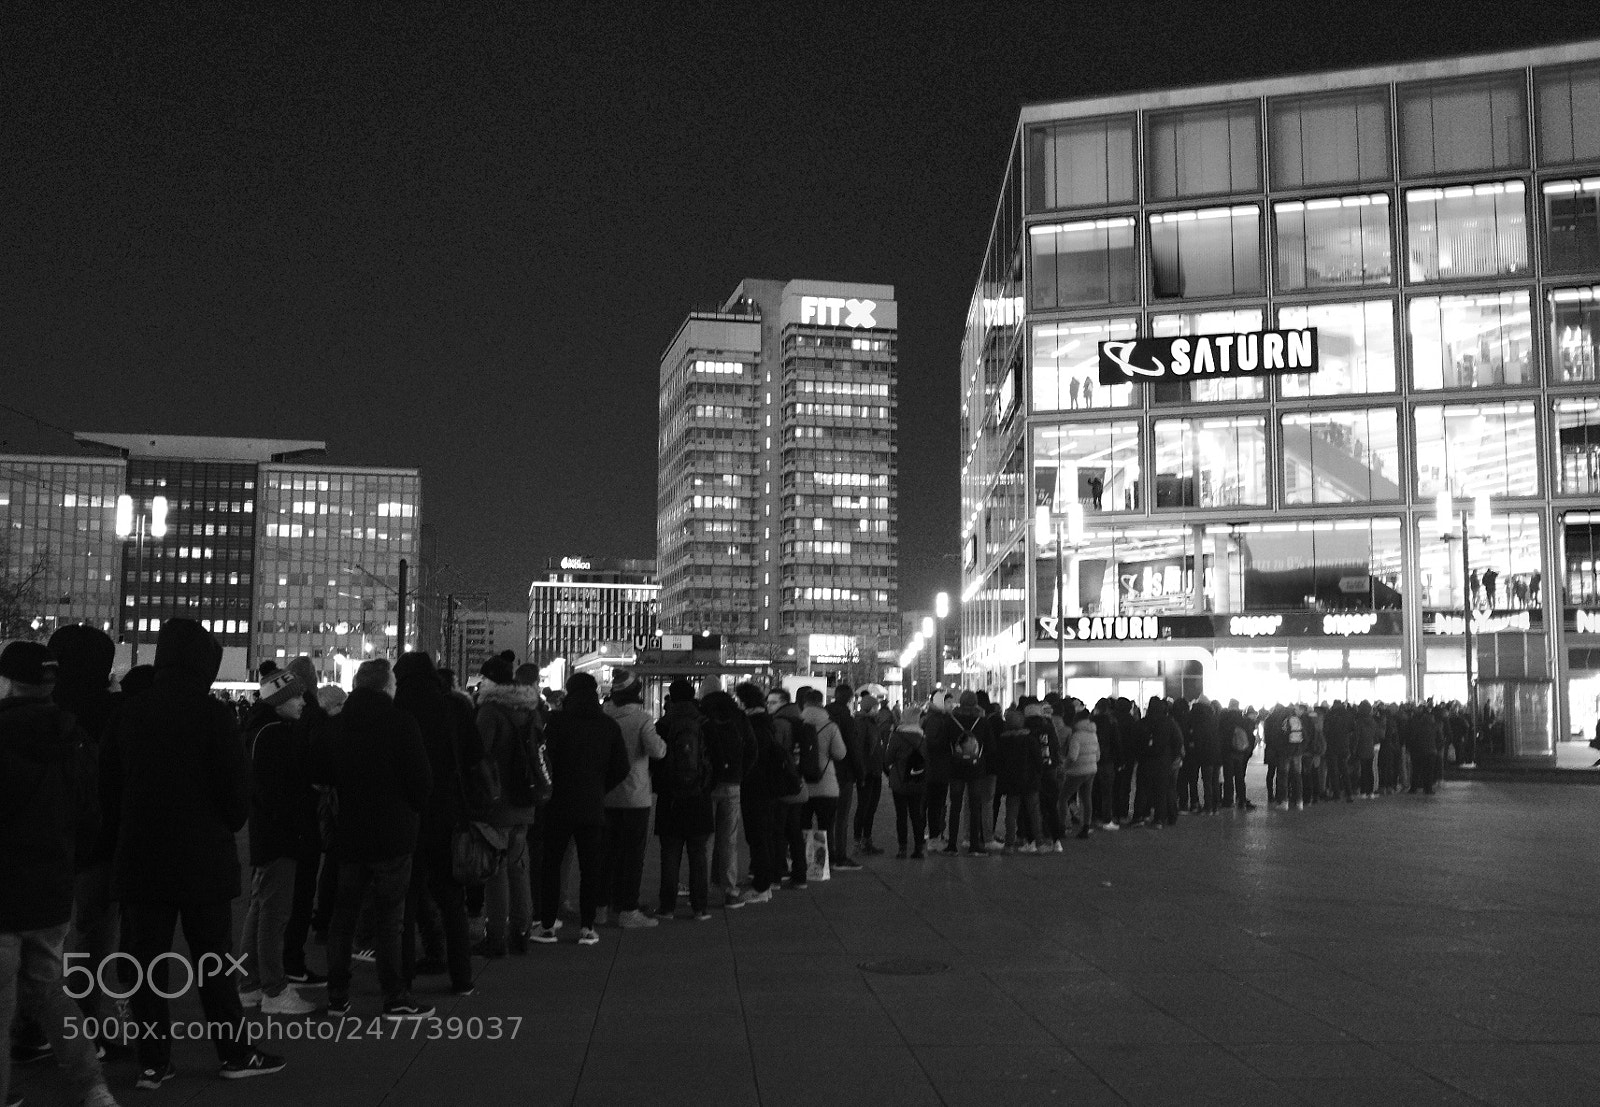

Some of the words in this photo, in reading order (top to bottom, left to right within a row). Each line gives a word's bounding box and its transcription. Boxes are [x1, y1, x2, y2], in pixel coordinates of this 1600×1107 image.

[801, 296, 877, 328] FITX
[1170, 330, 1312, 376] SATURN
[1077, 616, 1159, 640] SATURN
